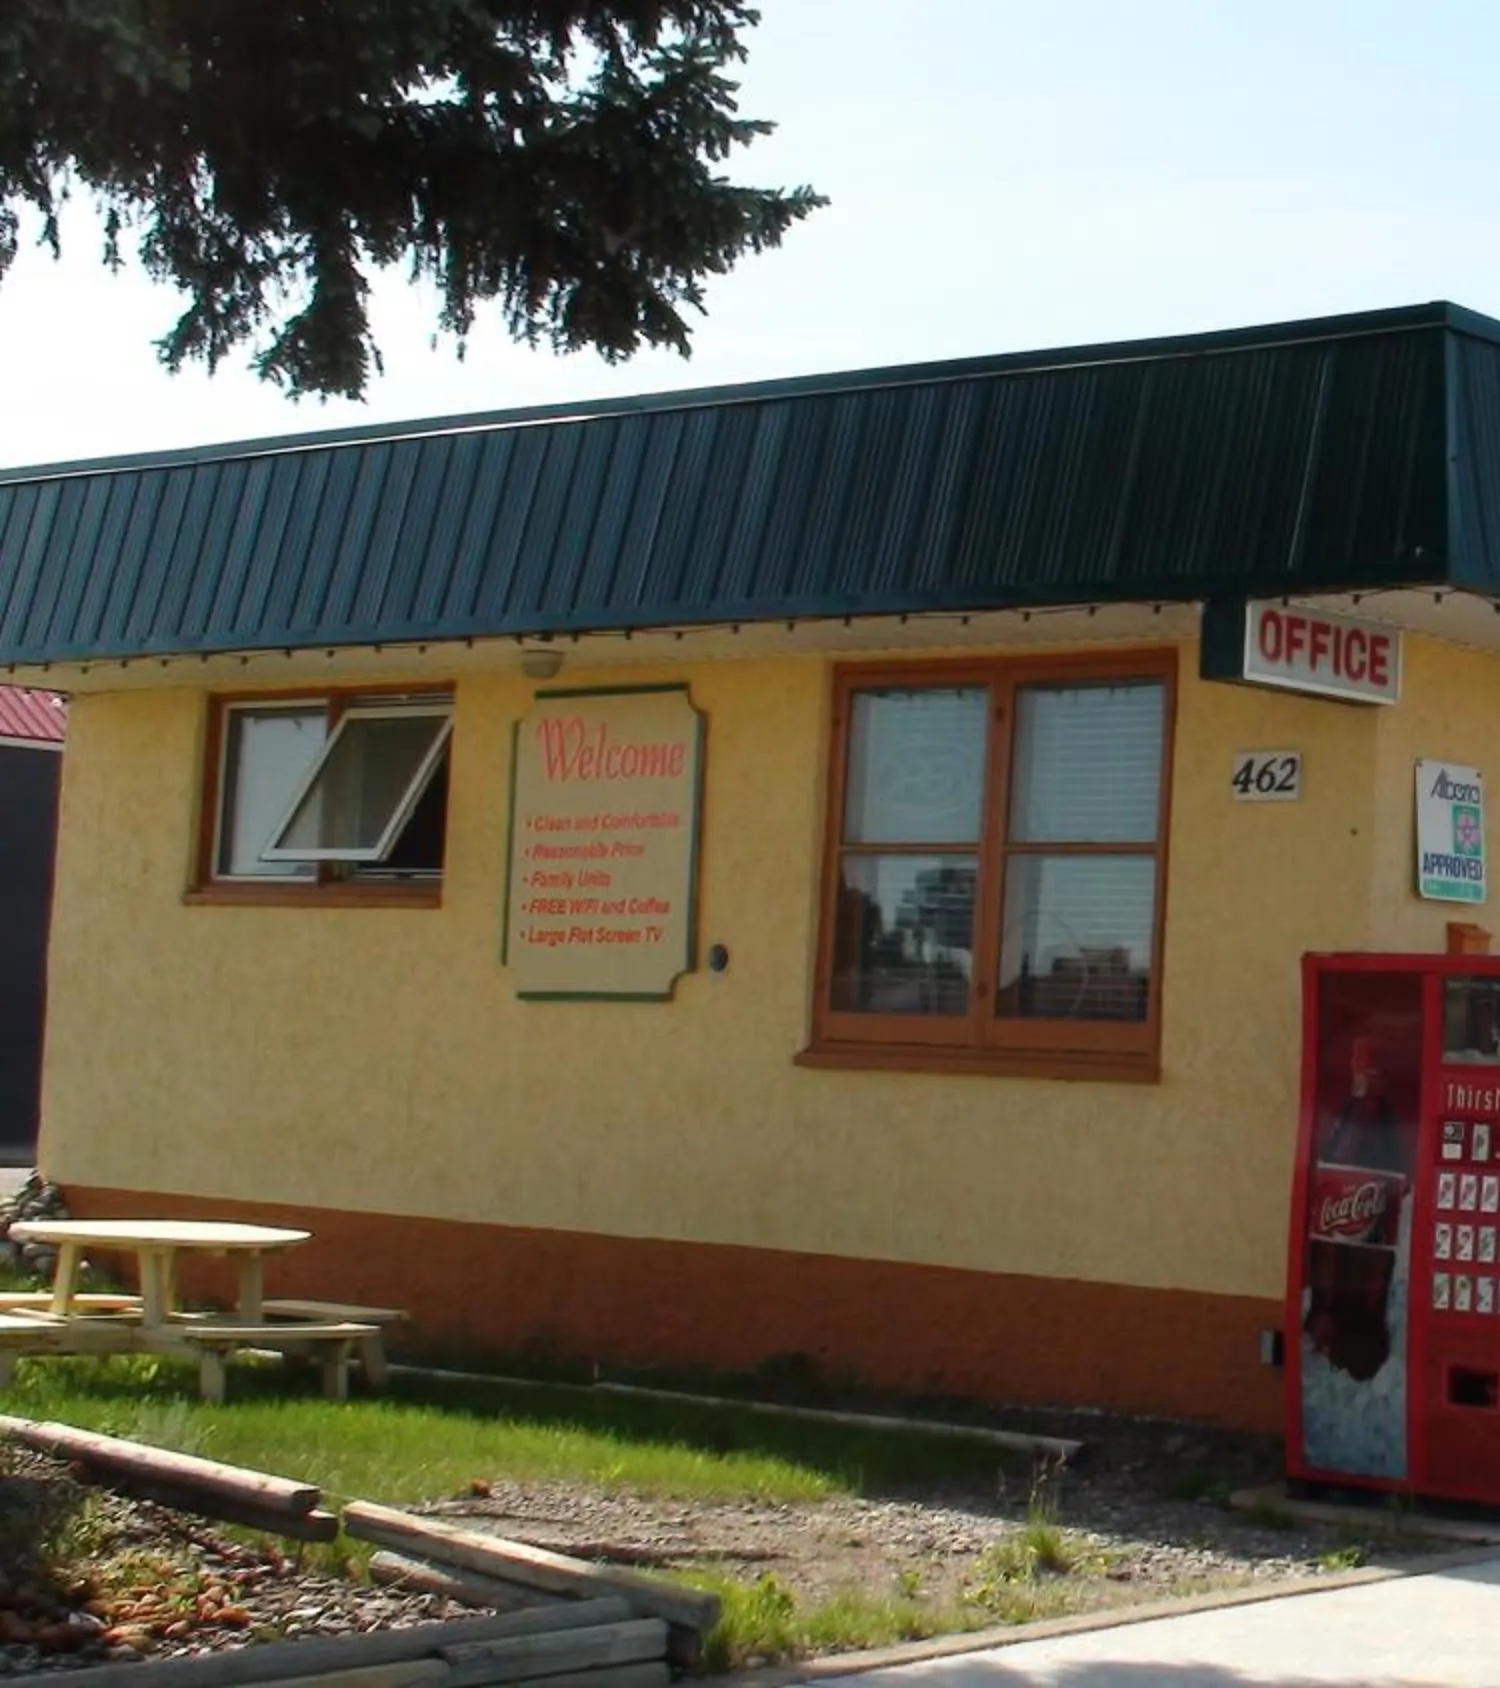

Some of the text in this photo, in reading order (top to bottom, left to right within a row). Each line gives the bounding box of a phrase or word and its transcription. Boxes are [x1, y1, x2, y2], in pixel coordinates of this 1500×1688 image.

[1258, 608, 1390, 687] OFFICE
[536, 716, 686, 782] Welcome
[1232, 756, 1298, 794] 462
[1429, 766, 1481, 804] Alberta
[534, 811, 679, 832] Clean and Comfortable
[532, 842, 608, 861] Reasonable
[1422, 851, 1482, 881] APPROVED
[530, 869, 612, 890] Family Units
[529, 898, 568, 914] FREE
[601, 898, 627, 914] and
[628, 897, 671, 914] Coffee
[528, 925, 664, 946] Large Flat Screen TV
